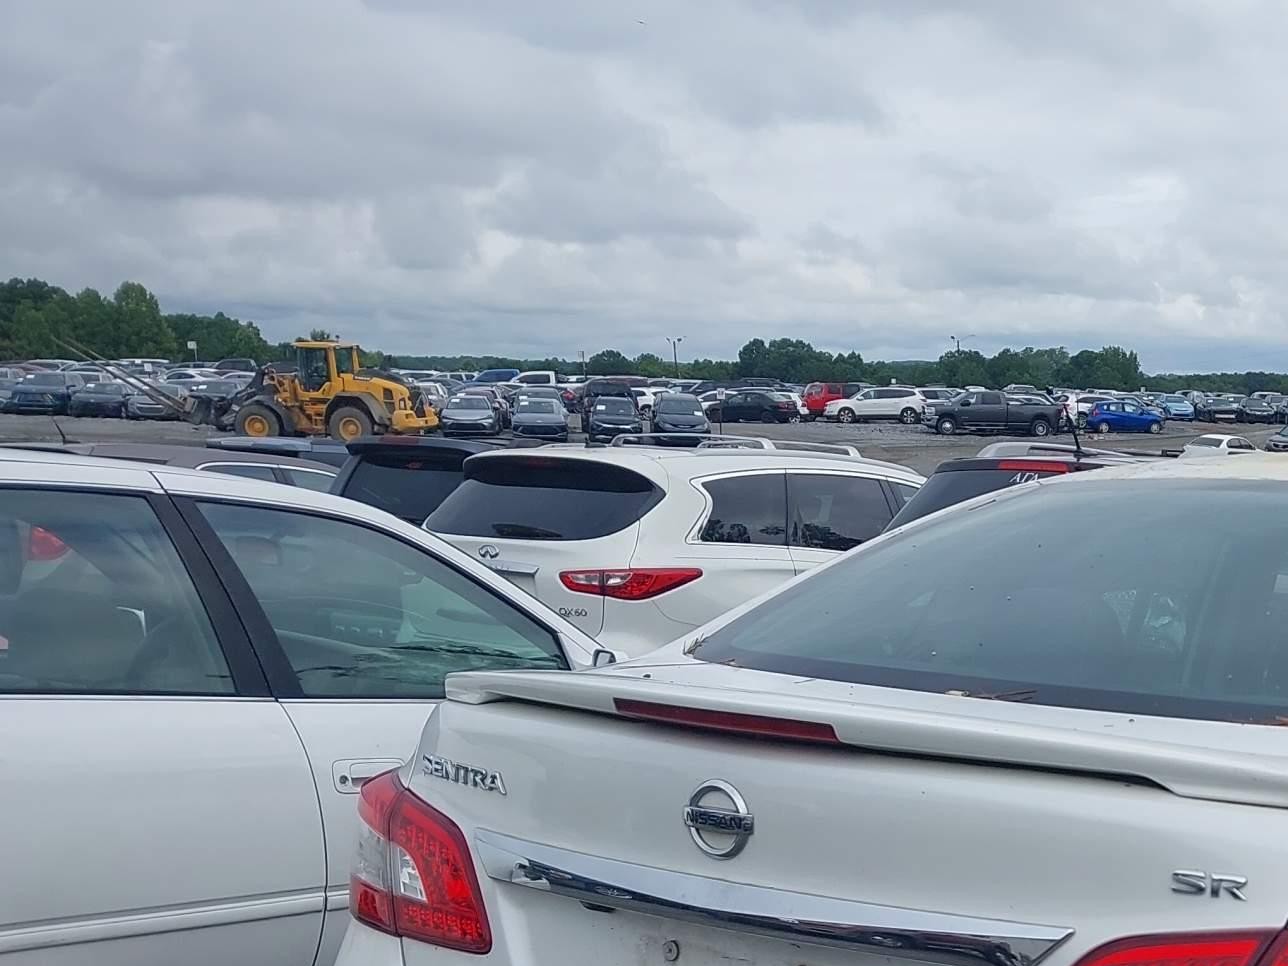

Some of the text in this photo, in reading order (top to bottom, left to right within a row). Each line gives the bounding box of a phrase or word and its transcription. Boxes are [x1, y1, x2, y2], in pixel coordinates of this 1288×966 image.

[558, 607, 588, 618] QX60
[422, 753, 508, 796] SENTRA
[684, 807, 747, 832] NISSAN
[1171, 869, 1248, 902] SR
